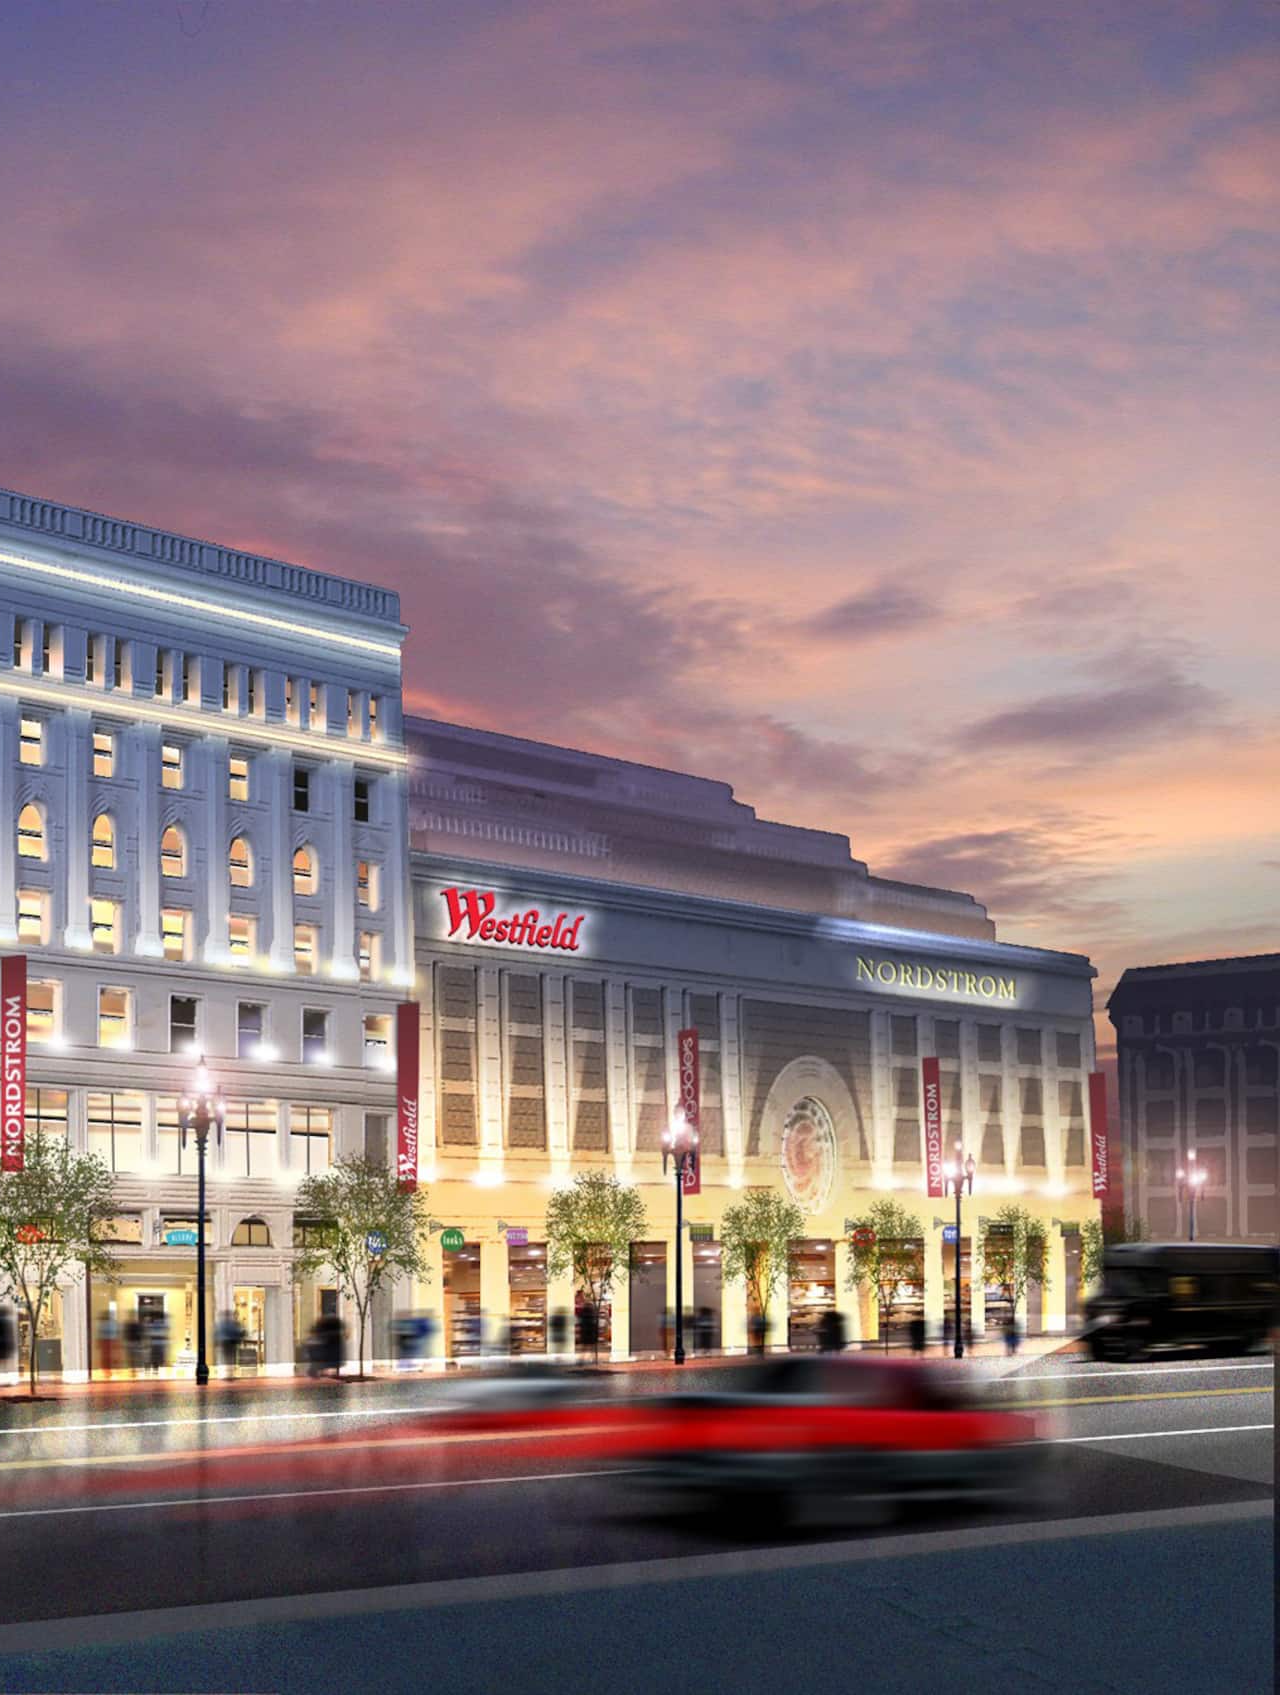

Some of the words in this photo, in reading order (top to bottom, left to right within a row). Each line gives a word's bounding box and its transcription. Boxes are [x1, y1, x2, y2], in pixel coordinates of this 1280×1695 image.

[439, 886, 586, 952] Westfield
[855, 954, 1018, 1001] NORDSTROM
[4, 995, 22, 1157] NORDSTROM
[398, 1096, 417, 1182] Westfield
[926, 1083, 941, 1189] NORDSTROM
[1093, 1132, 1107, 1192] Westfield
